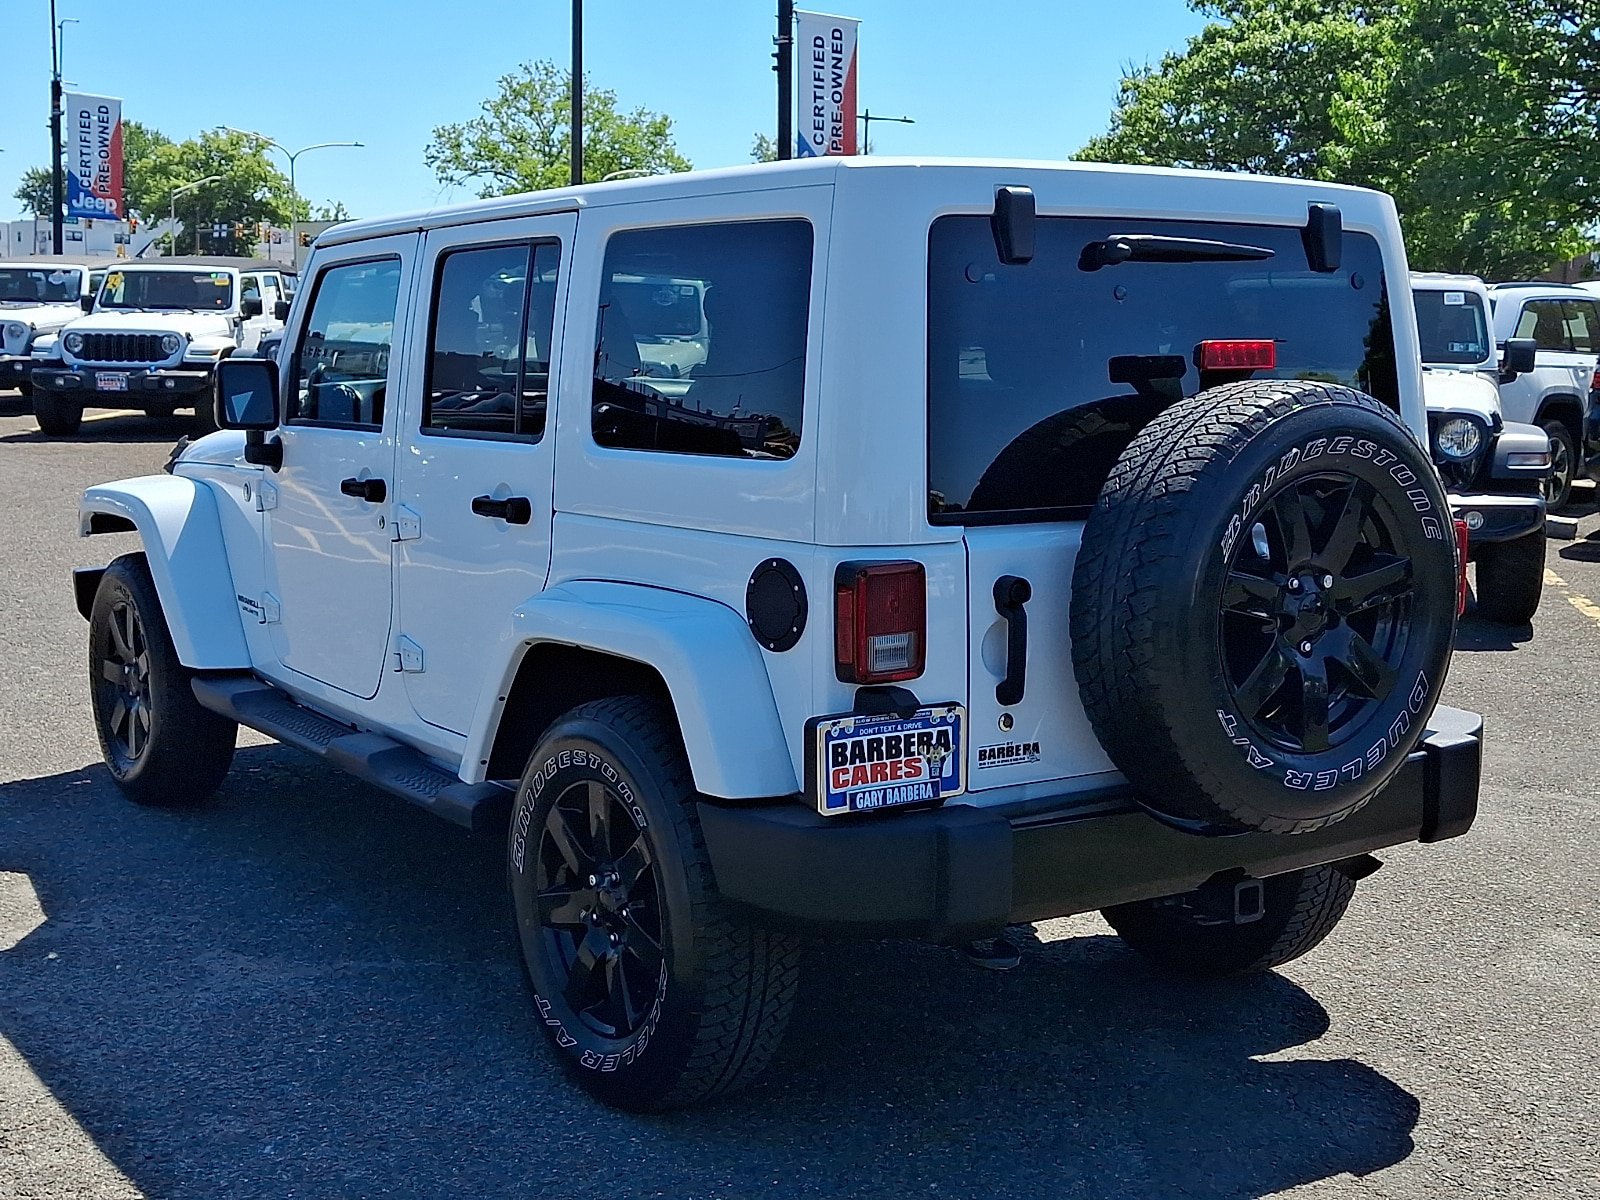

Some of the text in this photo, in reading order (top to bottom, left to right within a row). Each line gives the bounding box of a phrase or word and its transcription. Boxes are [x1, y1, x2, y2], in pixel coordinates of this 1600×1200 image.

[812, 35, 825, 146] CERTIFIED
[831, 27, 843, 151] PRE-OWNED
[79, 109, 91, 189] CERTIFIED
[98, 104, 109, 193] PRE-OWNED
[71, 191, 118, 214] Jeep
[1220, 435, 1443, 565] BRIDGESTONE
[831, 728, 952, 769] BARBERA
[859, 725, 879, 735] DON'T
[879, 724, 895, 733] TEXT
[903, 721, 923, 730] DRIVE
[978, 741, 1040, 761] BARBERA
[1216, 669, 1429, 790] DUELER A/T
[832, 757, 923, 790] CARES
[856, 783, 933, 809] GARY BARBERA
[513, 750, 647, 874] BRIDGESTONE
[534, 994, 577, 1048] A/T
